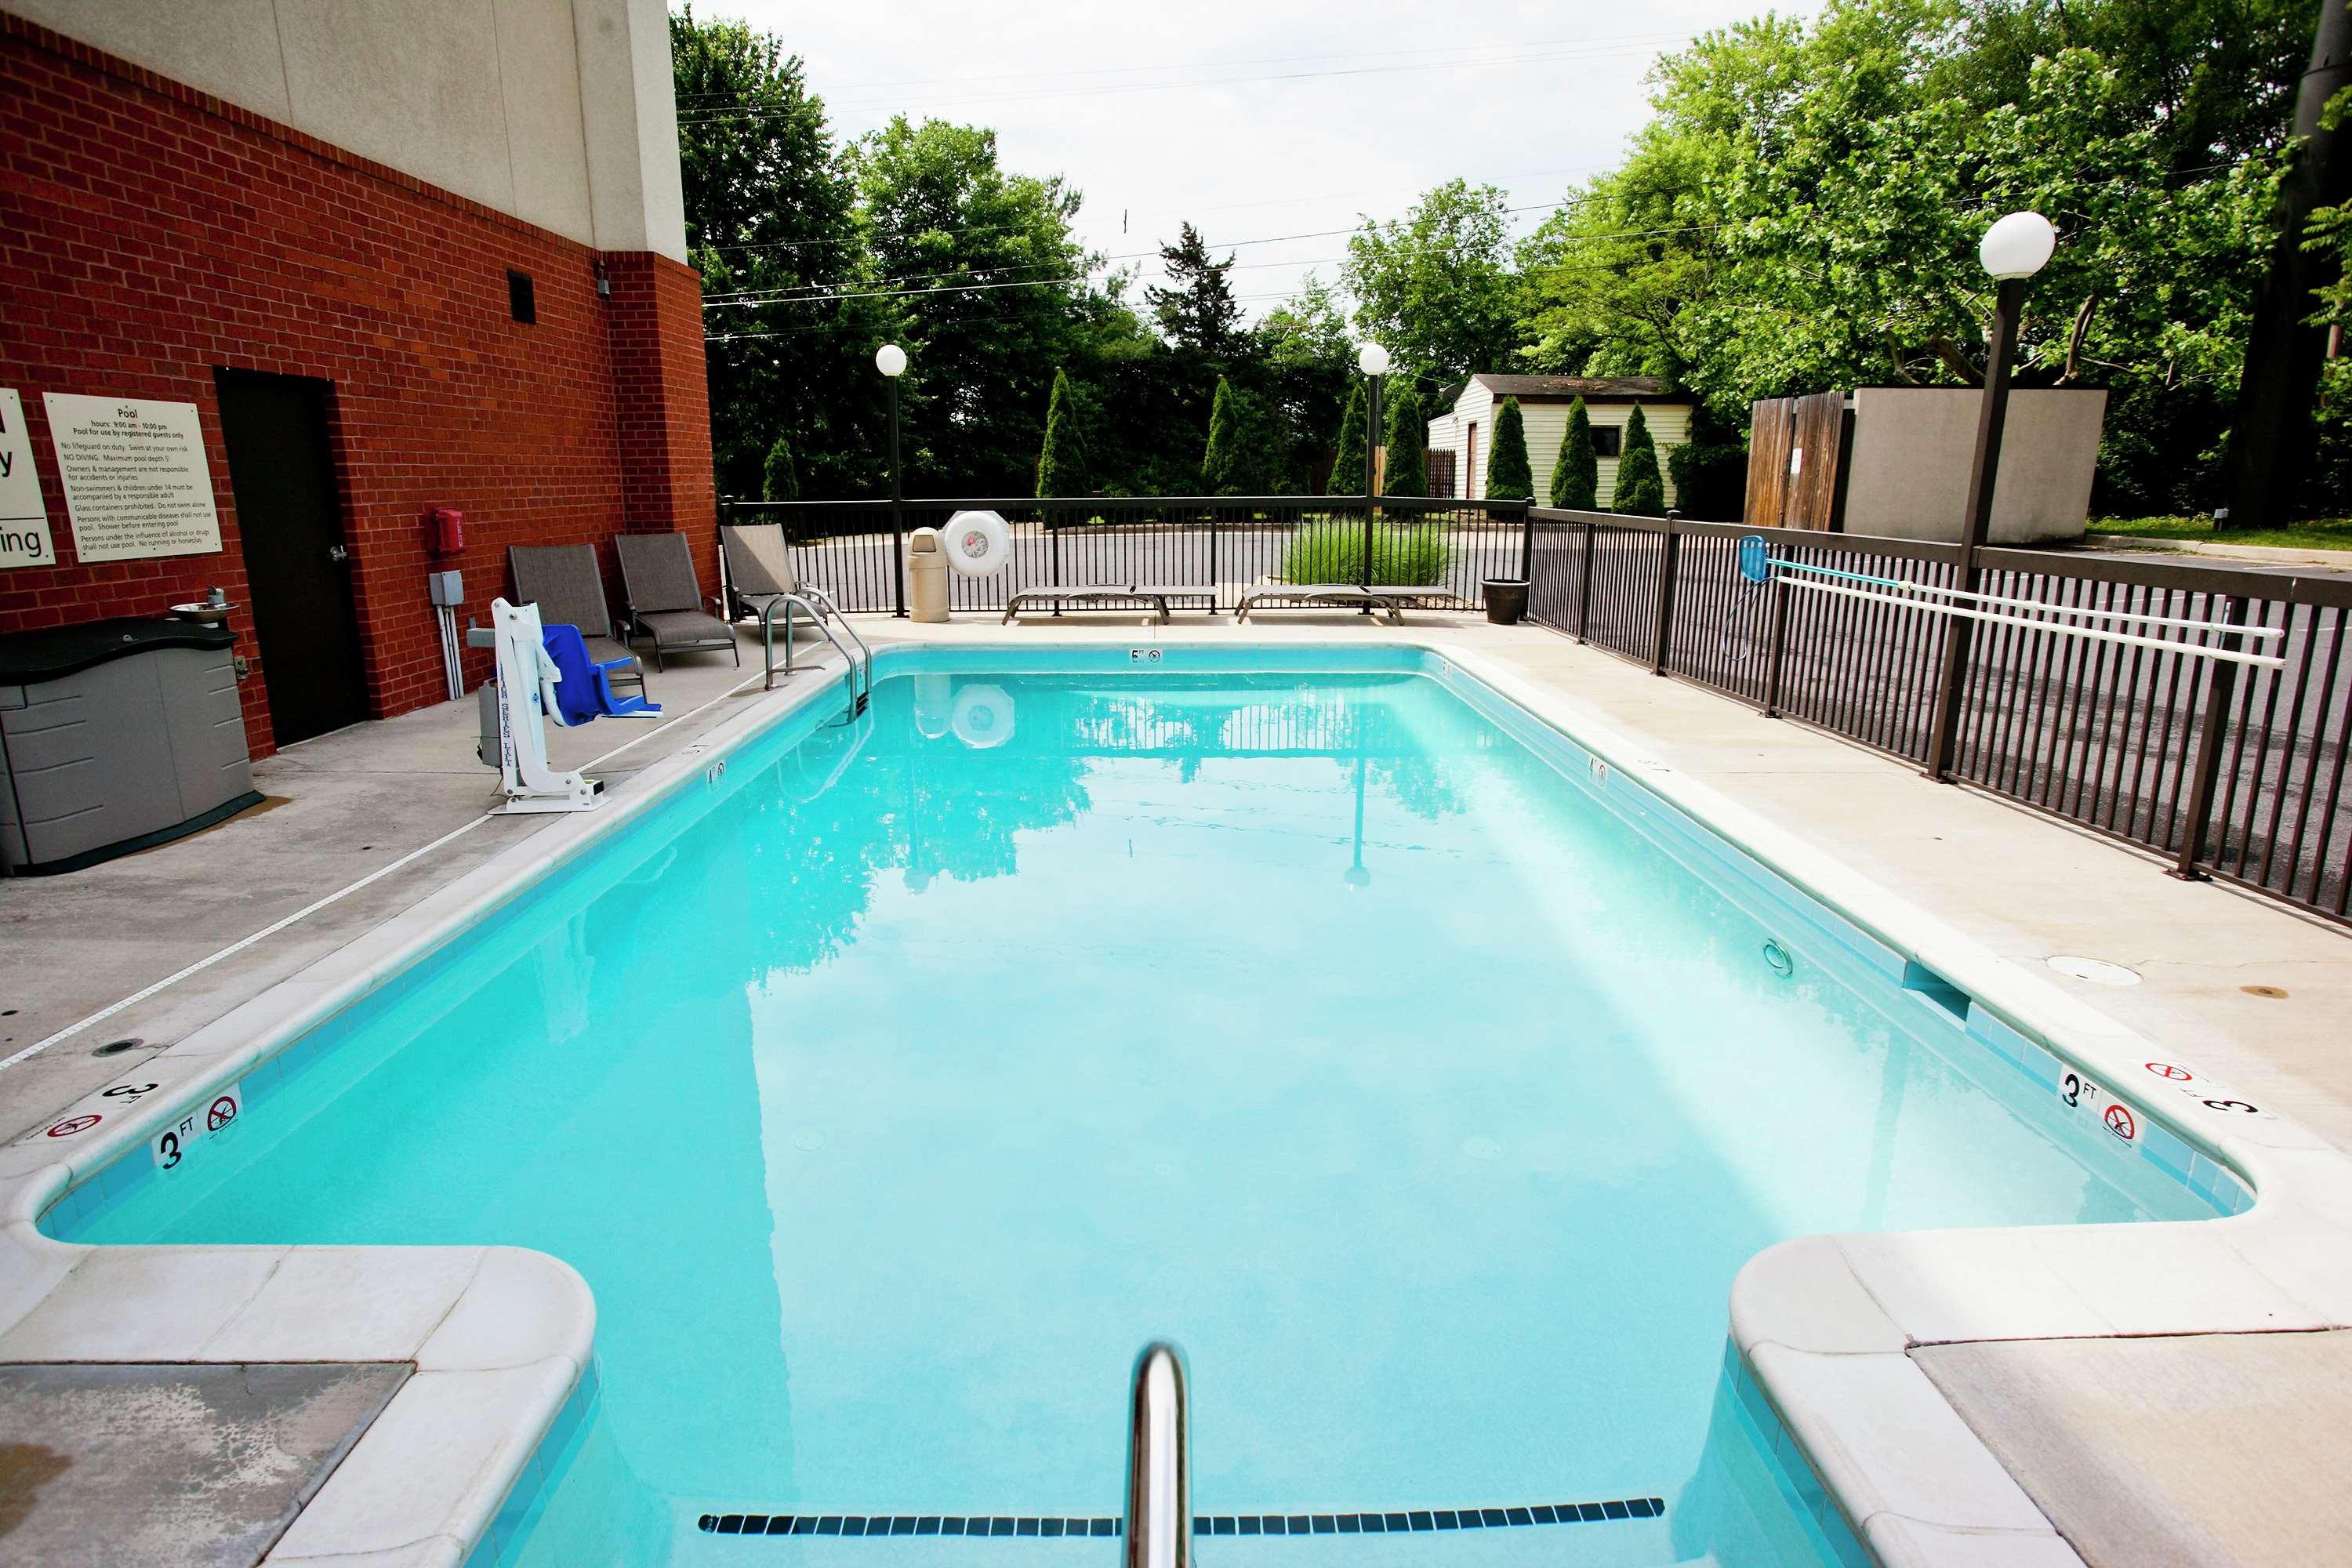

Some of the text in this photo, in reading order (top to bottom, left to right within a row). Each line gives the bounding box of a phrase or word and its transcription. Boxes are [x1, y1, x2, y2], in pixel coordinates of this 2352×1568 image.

[118, 408, 138, 419] Pool
[91, 419, 111, 428] hours:
[113, 429, 121, 437] by
[72, 442, 100, 452] lifeguard
[134, 455, 147, 463] pool
[148, 455, 164, 463] depth
[99, 466, 138, 474] management
[114, 492, 122, 501] by
[128, 492, 158, 500] responsible
[117, 513, 157, 521] communicable
[98, 521, 121, 530] Shower
[142, 521, 165, 529] entering
[81, 534, 104, 543] Persons
[149, 539, 171, 547] running
[178, 537, 202, 546] horseplay
[102, 1083, 159, 1097] 3
[2062, 1073, 2096, 1107] 3 FT
[2202, 1100, 2258, 1113] 3
[161, 1116, 193, 1170] 3 FT
